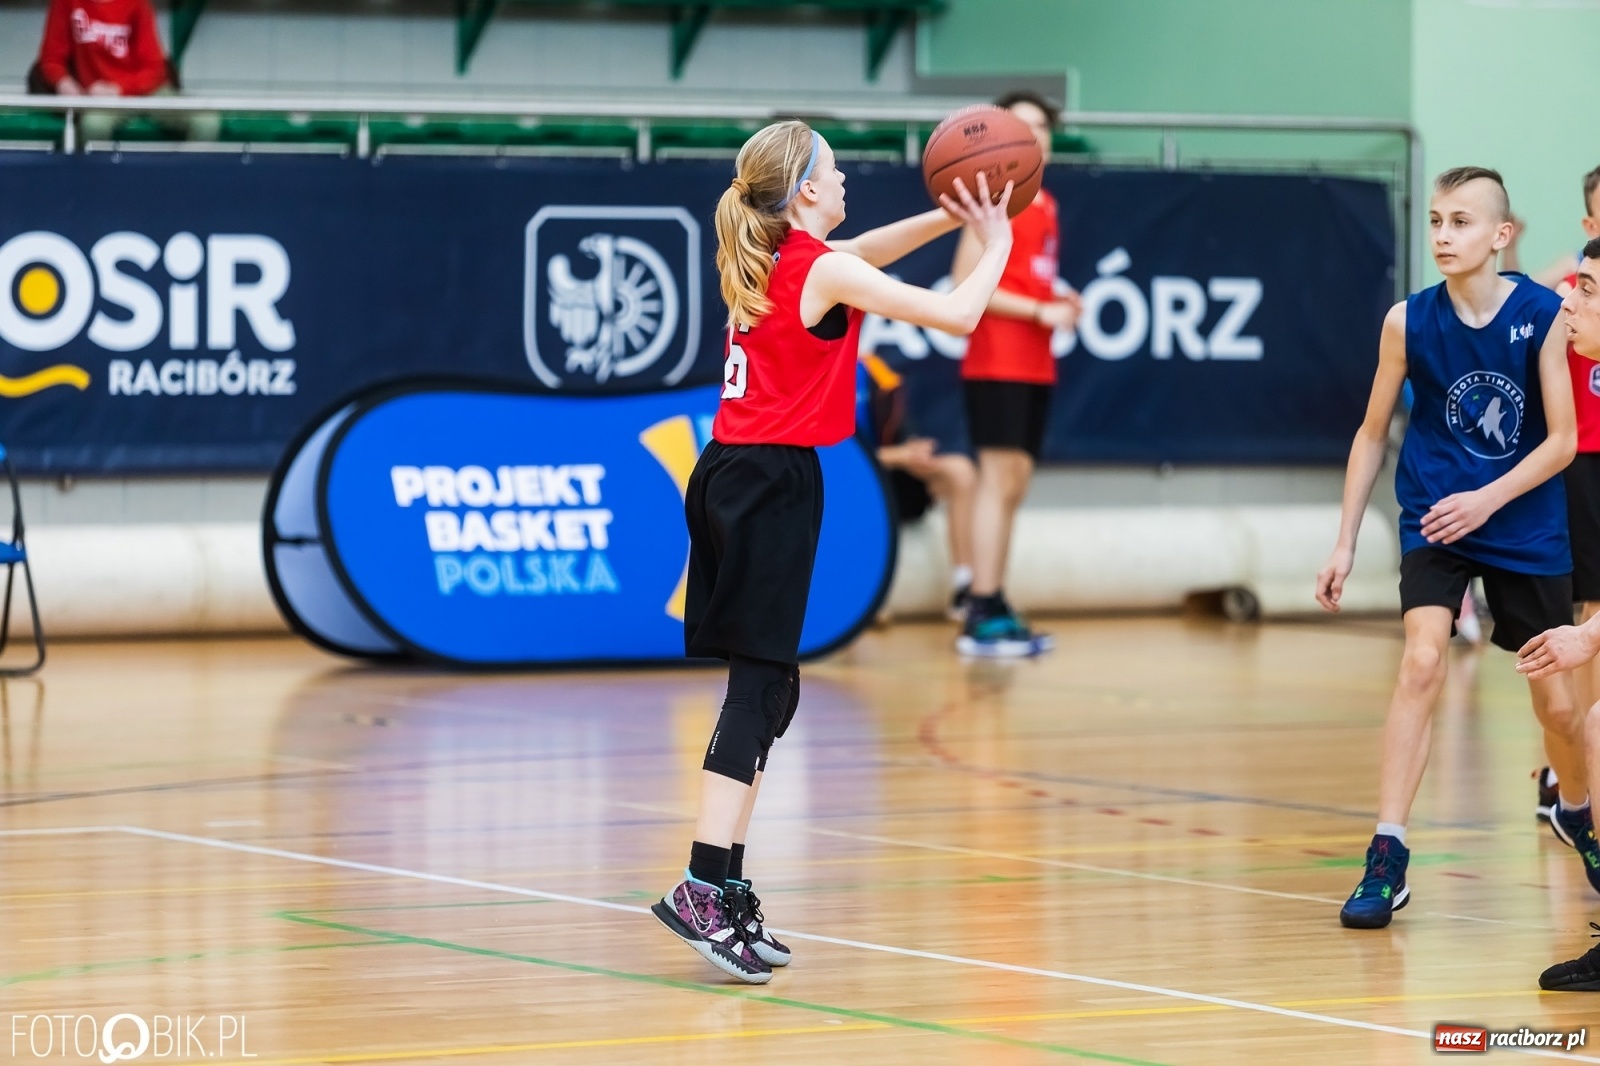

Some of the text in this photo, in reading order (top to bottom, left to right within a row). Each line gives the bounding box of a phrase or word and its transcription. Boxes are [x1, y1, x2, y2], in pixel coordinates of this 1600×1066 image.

[109, 350, 297, 396] RACIBÓRZ
[390, 463, 606, 507] PROJEKT
[424, 508, 614, 552] BASKET
[433, 551, 620, 596] POLSKA
